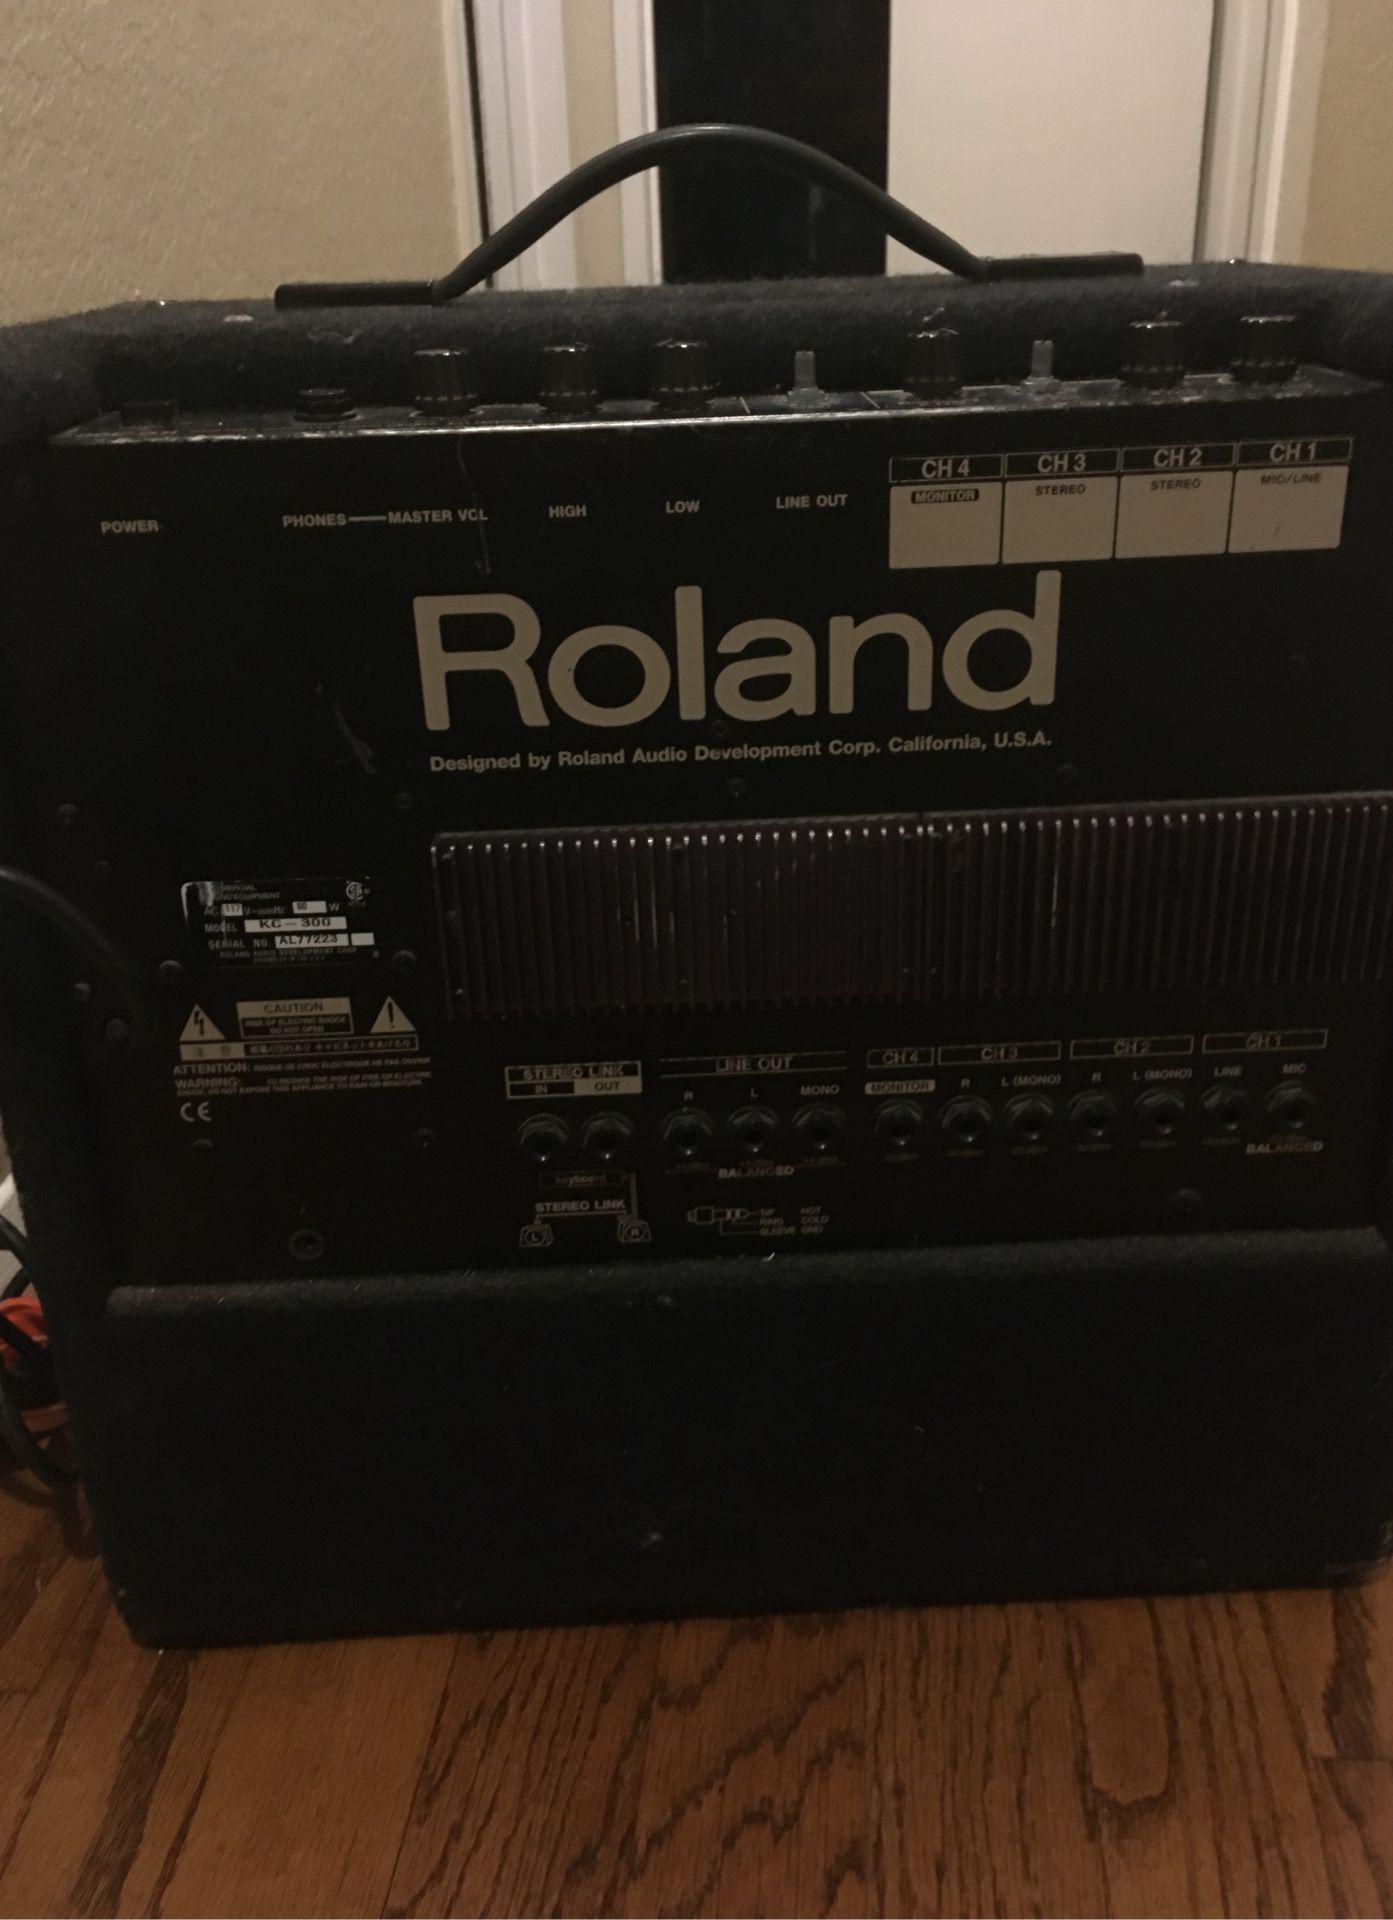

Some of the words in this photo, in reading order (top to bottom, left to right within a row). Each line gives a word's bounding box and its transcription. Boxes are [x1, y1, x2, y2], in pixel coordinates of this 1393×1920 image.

[1153, 449, 1184, 469] CH
[1187, 448, 1201, 466] 2
[1269, 442, 1302, 462] CH
[1307, 441, 1316, 461] 1
[921, 460, 953, 480] CH
[956, 459, 970, 478] 4
[1037, 455, 1069, 473] CH
[1072, 453, 1086, 472] 3
[1035, 484, 1086, 496] STEREO
[1150, 478, 1201, 491] STEREO
[776, 496, 810, 509] LINE
[816, 493, 848, 507] OUT
[914, 489, 976, 503] MONITOR
[549, 505, 587, 518] HIGH
[665, 499, 700, 514] LOW
[388, 509, 452, 524] MASTER
[457, 507, 488, 522] VOL
[101, 519, 160, 534] POWER
[412, 569, 1062, 731] Roland
[429, 753, 521, 773] Designed
[528, 750, 551, 771] by
[558, 746, 625, 767] Roland
[632, 743, 687, 763] Audio
[694, 739, 822, 764] Development
[829, 736, 882, 758] Corp.
[888, 732, 987, 754] California,
[994, 730, 1052, 748] U.S.A.
[208, 939, 246, 950] SERIAL
[279, 933, 338, 946] AL77223
[264, 1002, 323, 1015] CAUTION
[1113, 1040, 1138, 1056] CH
[1140, 1040, 1151, 1054] 2
[1246, 1034, 1272, 1050] CH
[1274, 1033, 1281, 1048] 1
[882, 1050, 906, 1065] CH
[908, 1049, 919, 1064] 4
[981, 1046, 1006, 1061] CH
[1009, 1046, 1018, 1060] 3
[715, 1058, 752, 1073] LINE
[757, 1057, 793, 1071] OUT
[1214, 1066, 1242, 1077] LINE
[1282, 1063, 1307, 1075] MIC
[523, 1067, 583, 1081] STEREO
[588, 1064, 625, 1077] LINK
[1092, 1072, 1101, 1082] R
[1133, 1071, 1141, 1081] L
[1144, 1067, 1193, 1081] (MONO)
[595, 1080, 620, 1092] OUT
[871, 1082, 930, 1093] MONITOR
[961, 1079, 970, 1089] R
[1001, 1076, 1009, 1086] L
[1013, 1074, 1061, 1087] (MONO)
[535, 1083, 548, 1094] IN
[751, 1088, 759, 1098] L
[800, 1085, 840, 1097] MONO
[684, 1091, 694, 1101] R
[1246, 1141, 1323, 1155] BALANCED
[718, 1166, 795, 1178] BALANCED
[535, 1200, 590, 1213] STEREO
[594, 1198, 626, 1210] LINK
